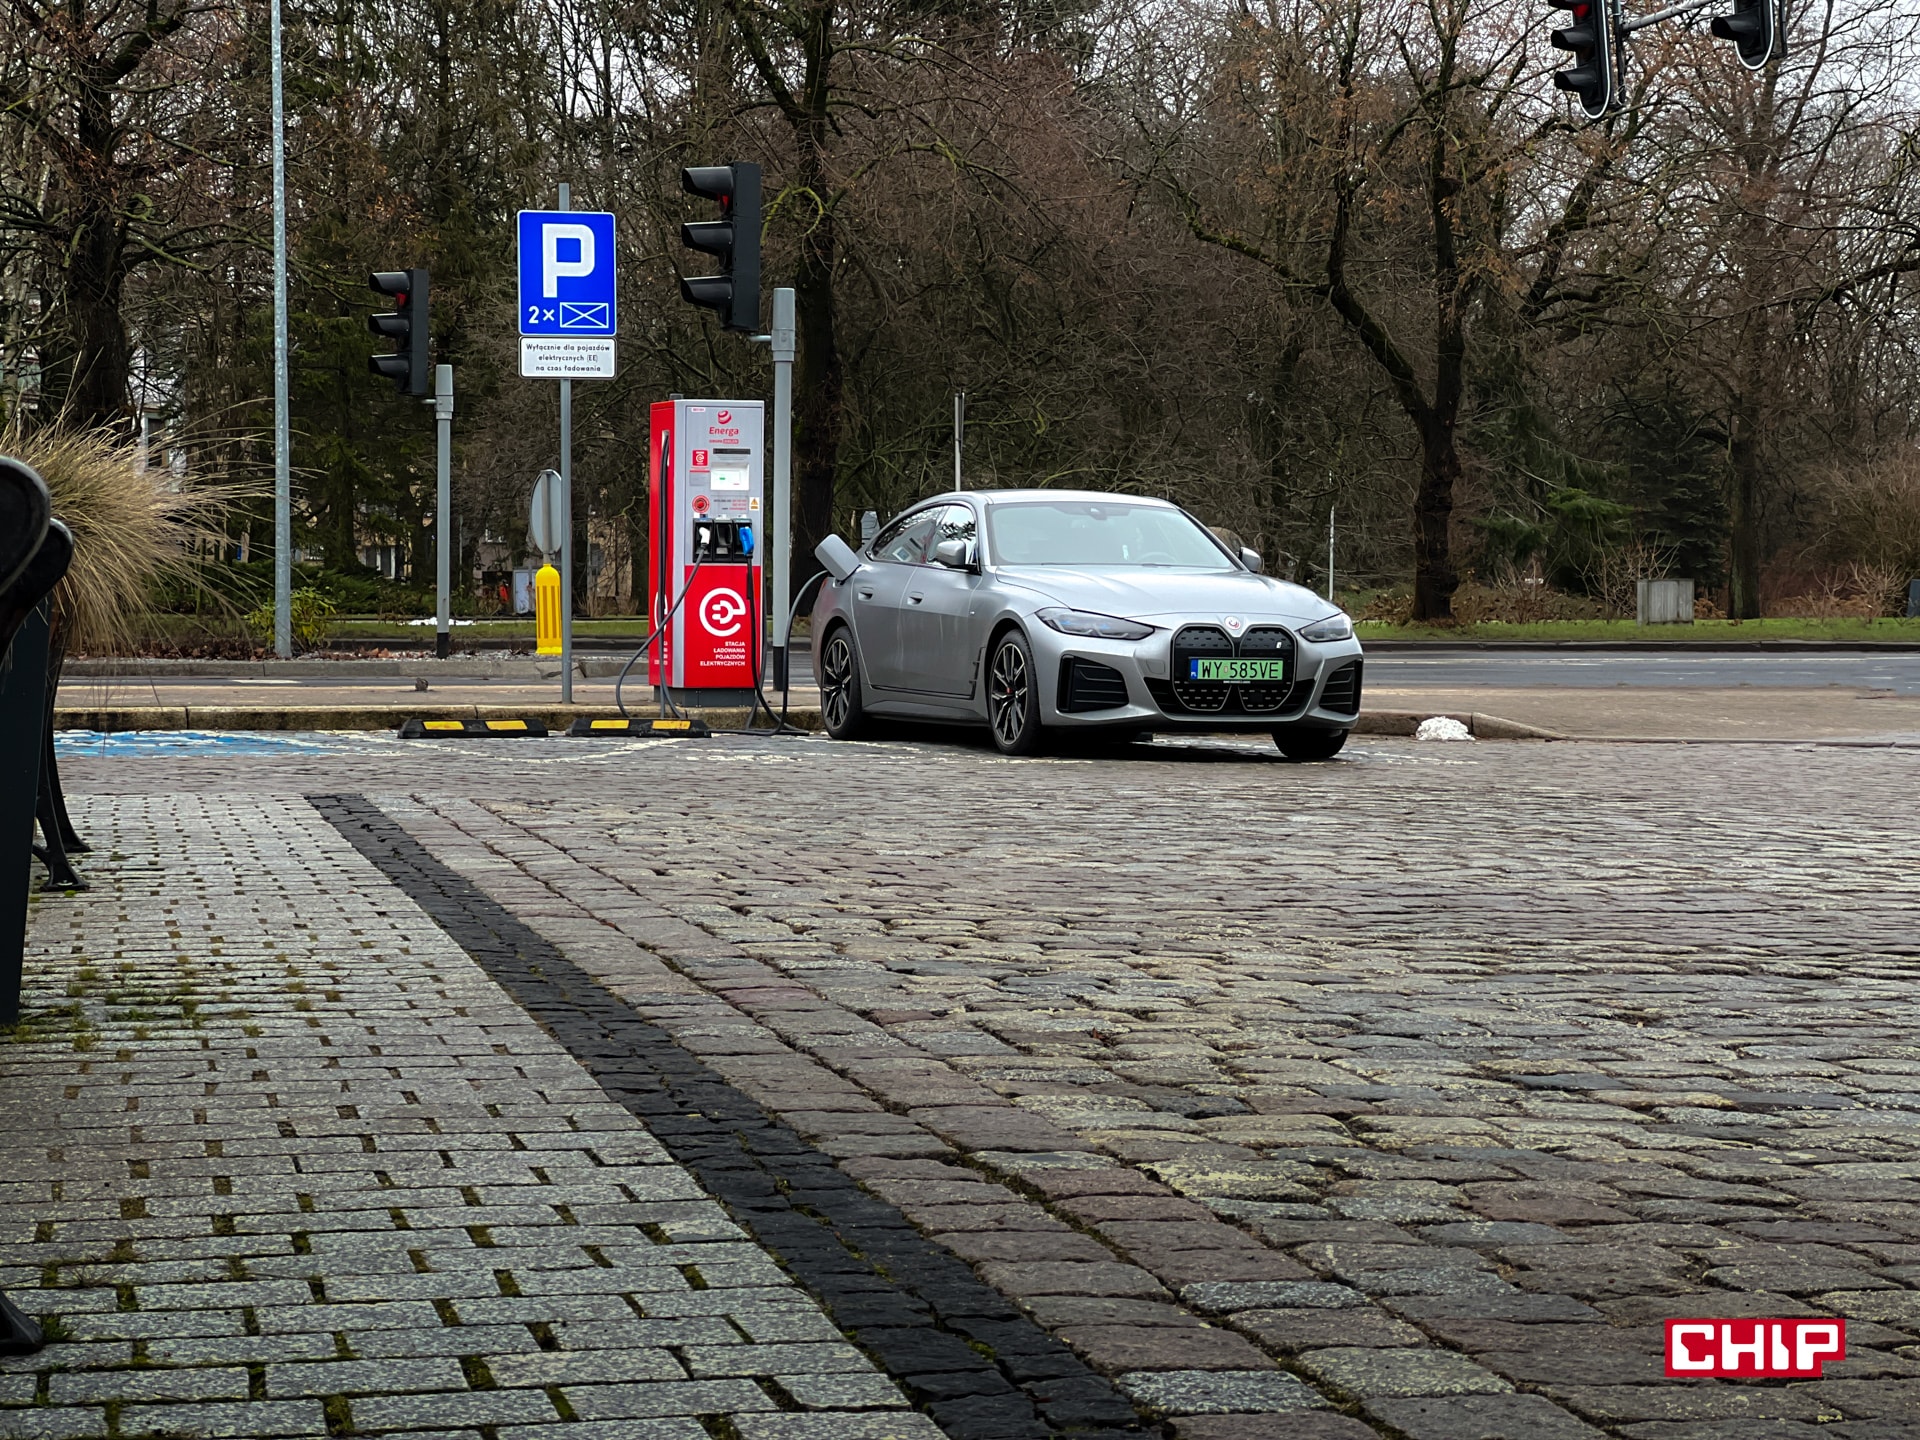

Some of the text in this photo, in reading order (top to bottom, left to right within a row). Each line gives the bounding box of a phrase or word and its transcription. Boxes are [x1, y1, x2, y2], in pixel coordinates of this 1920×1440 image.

[542, 223, 595, 298] P
[526, 344, 561, 352] Wyłącznie
[577, 344, 610, 353] pojazdów
[538, 355, 585, 363] elektrycznych
[709, 426, 739, 437] Energa
[1202, 662, 1279, 679] WY 585VE
